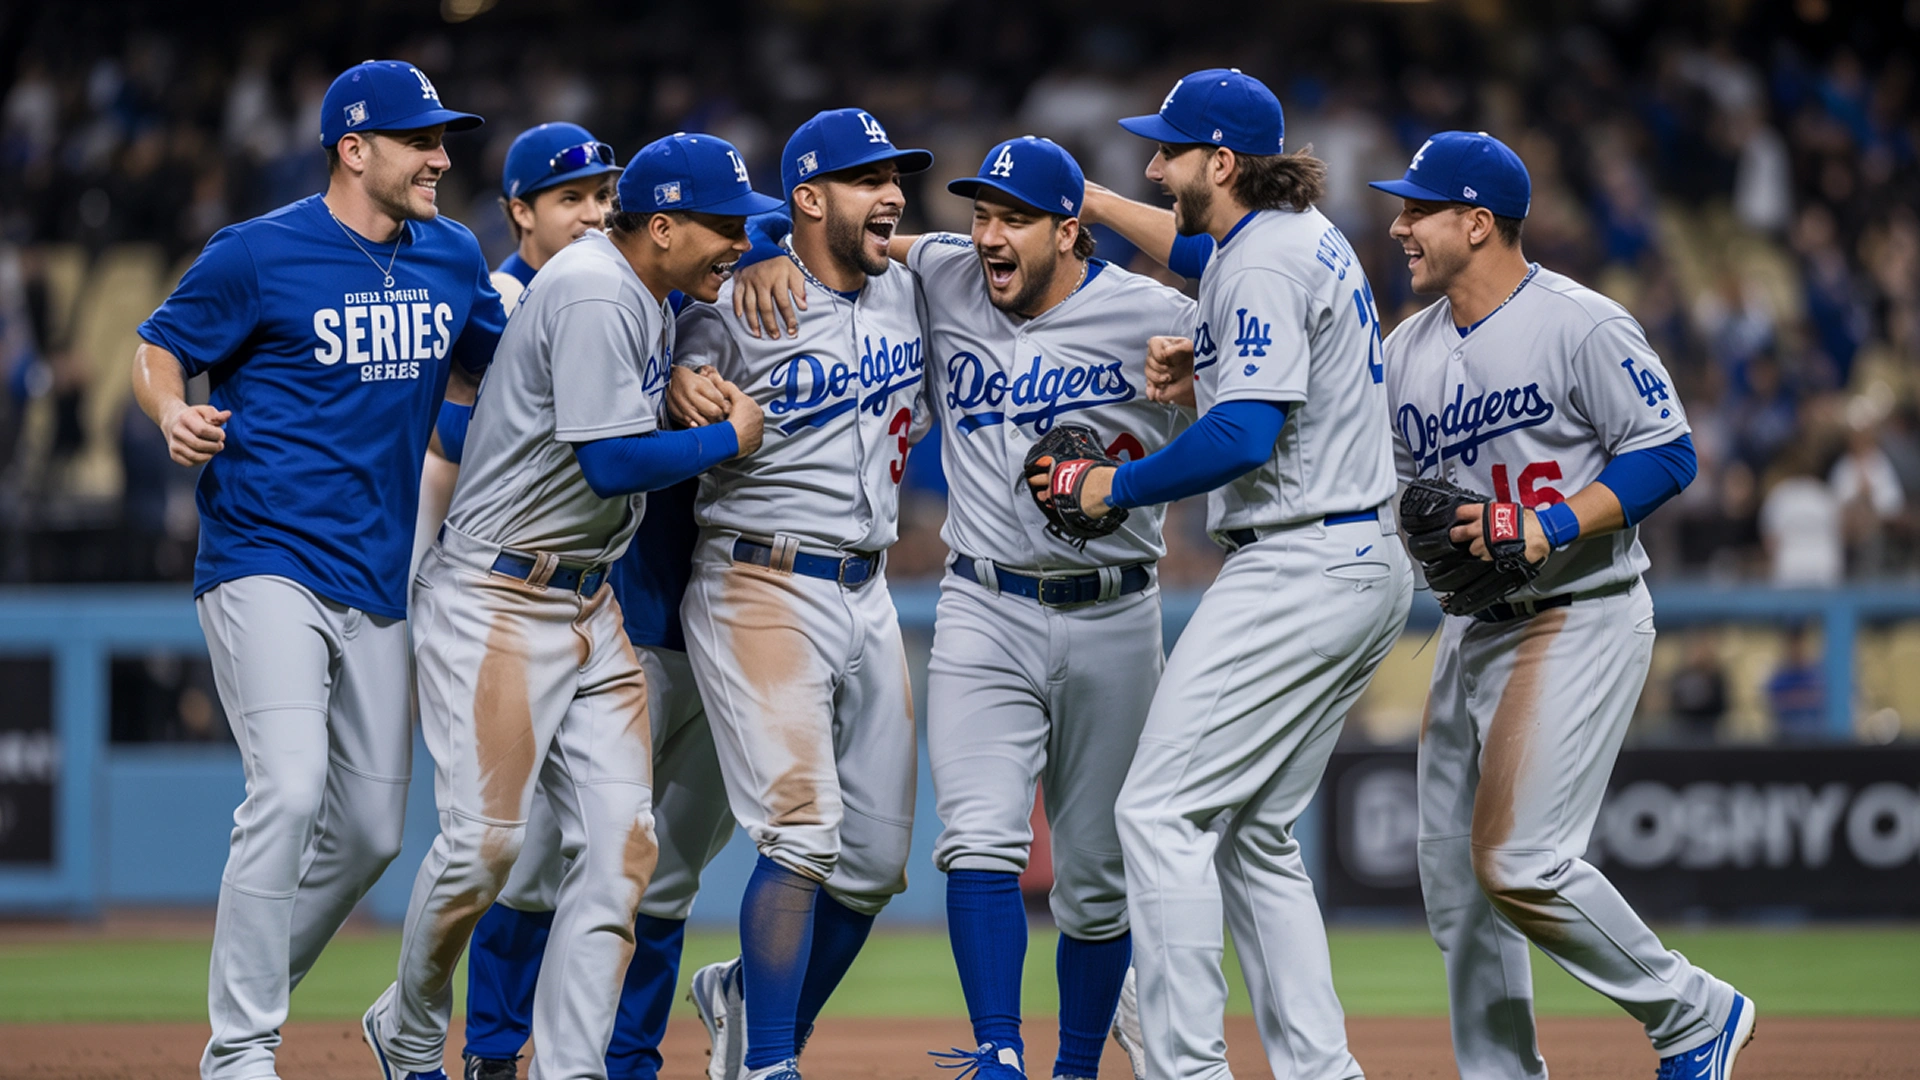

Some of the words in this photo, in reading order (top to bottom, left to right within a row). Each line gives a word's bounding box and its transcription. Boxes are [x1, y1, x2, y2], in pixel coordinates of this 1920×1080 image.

[857, 111, 889, 144] LA
[313, 302, 453, 365] SERIES
[1234, 308, 1272, 357] LA
[947, 354, 1136, 435] Dodgers
[1621, 357, 1670, 407] LA
[1397, 382, 1554, 467] Dodgers
[1491, 460, 1567, 509] 16
